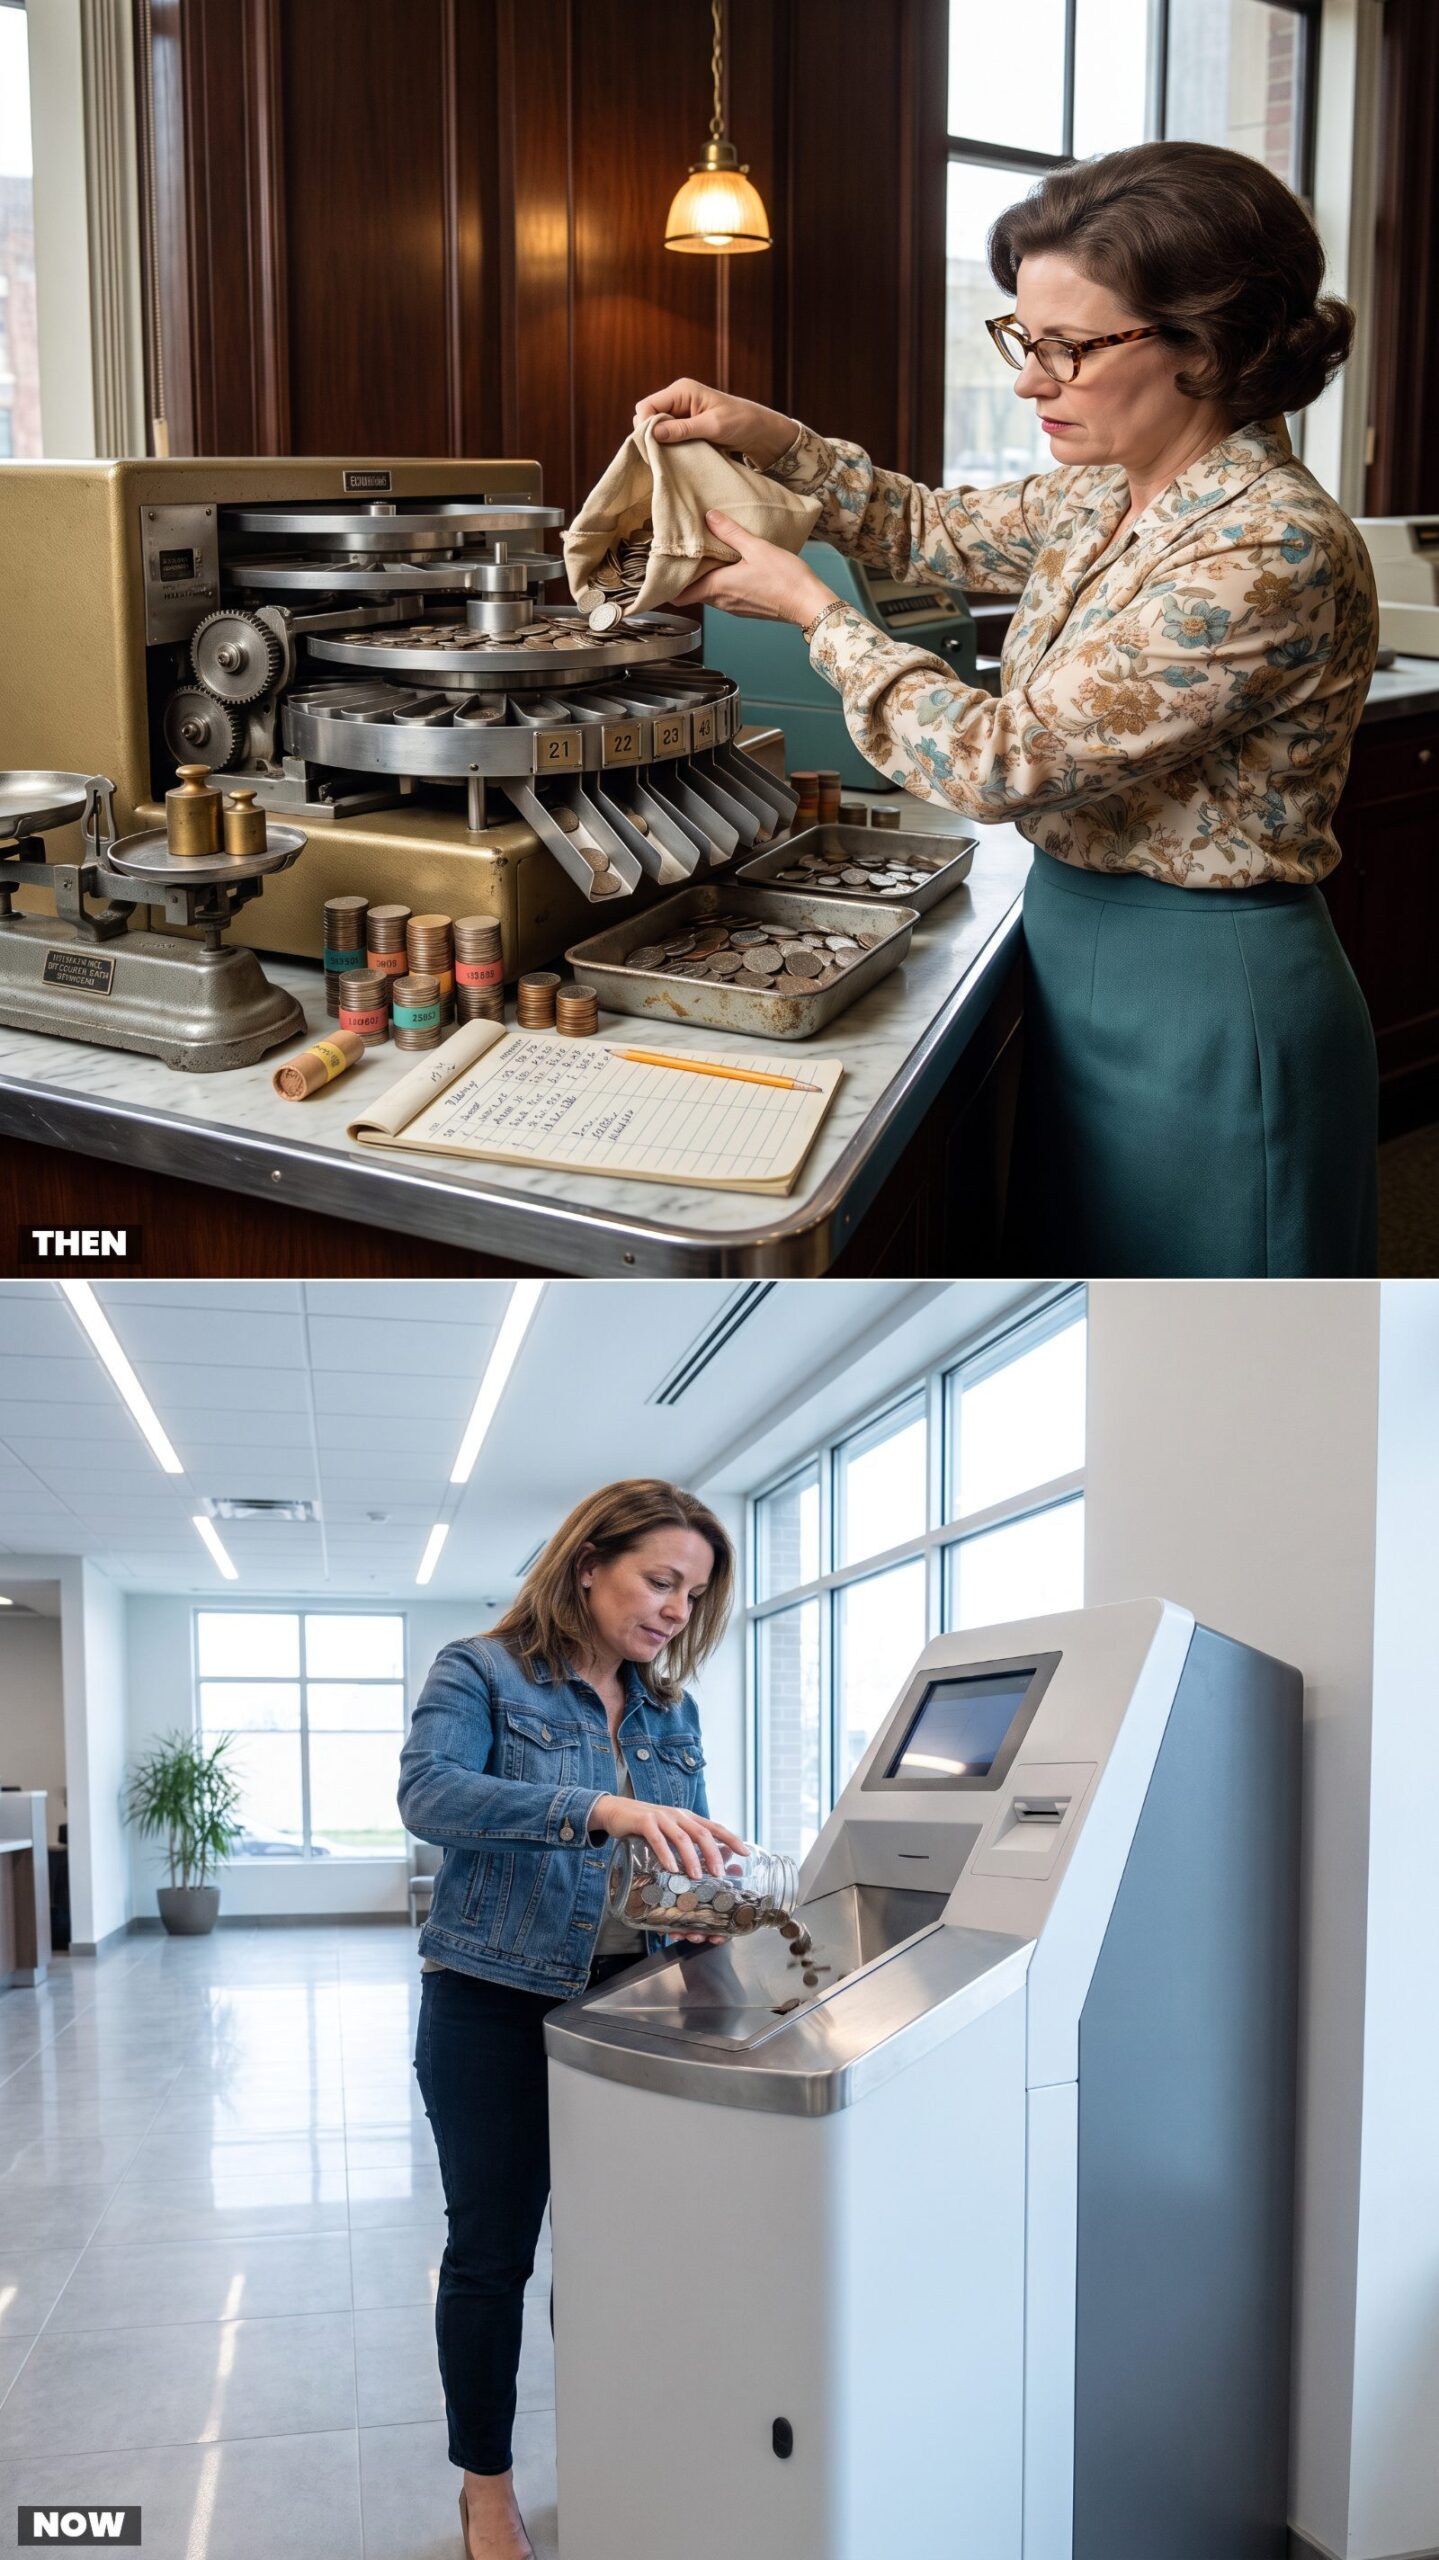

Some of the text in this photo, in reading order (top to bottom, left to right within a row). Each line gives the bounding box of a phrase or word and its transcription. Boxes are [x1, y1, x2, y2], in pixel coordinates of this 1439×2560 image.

[663, 727, 679, 745] 23
[698, 719, 711, 737] 43
[549, 740, 569, 759] 21
[614, 735, 632, 753] 22
